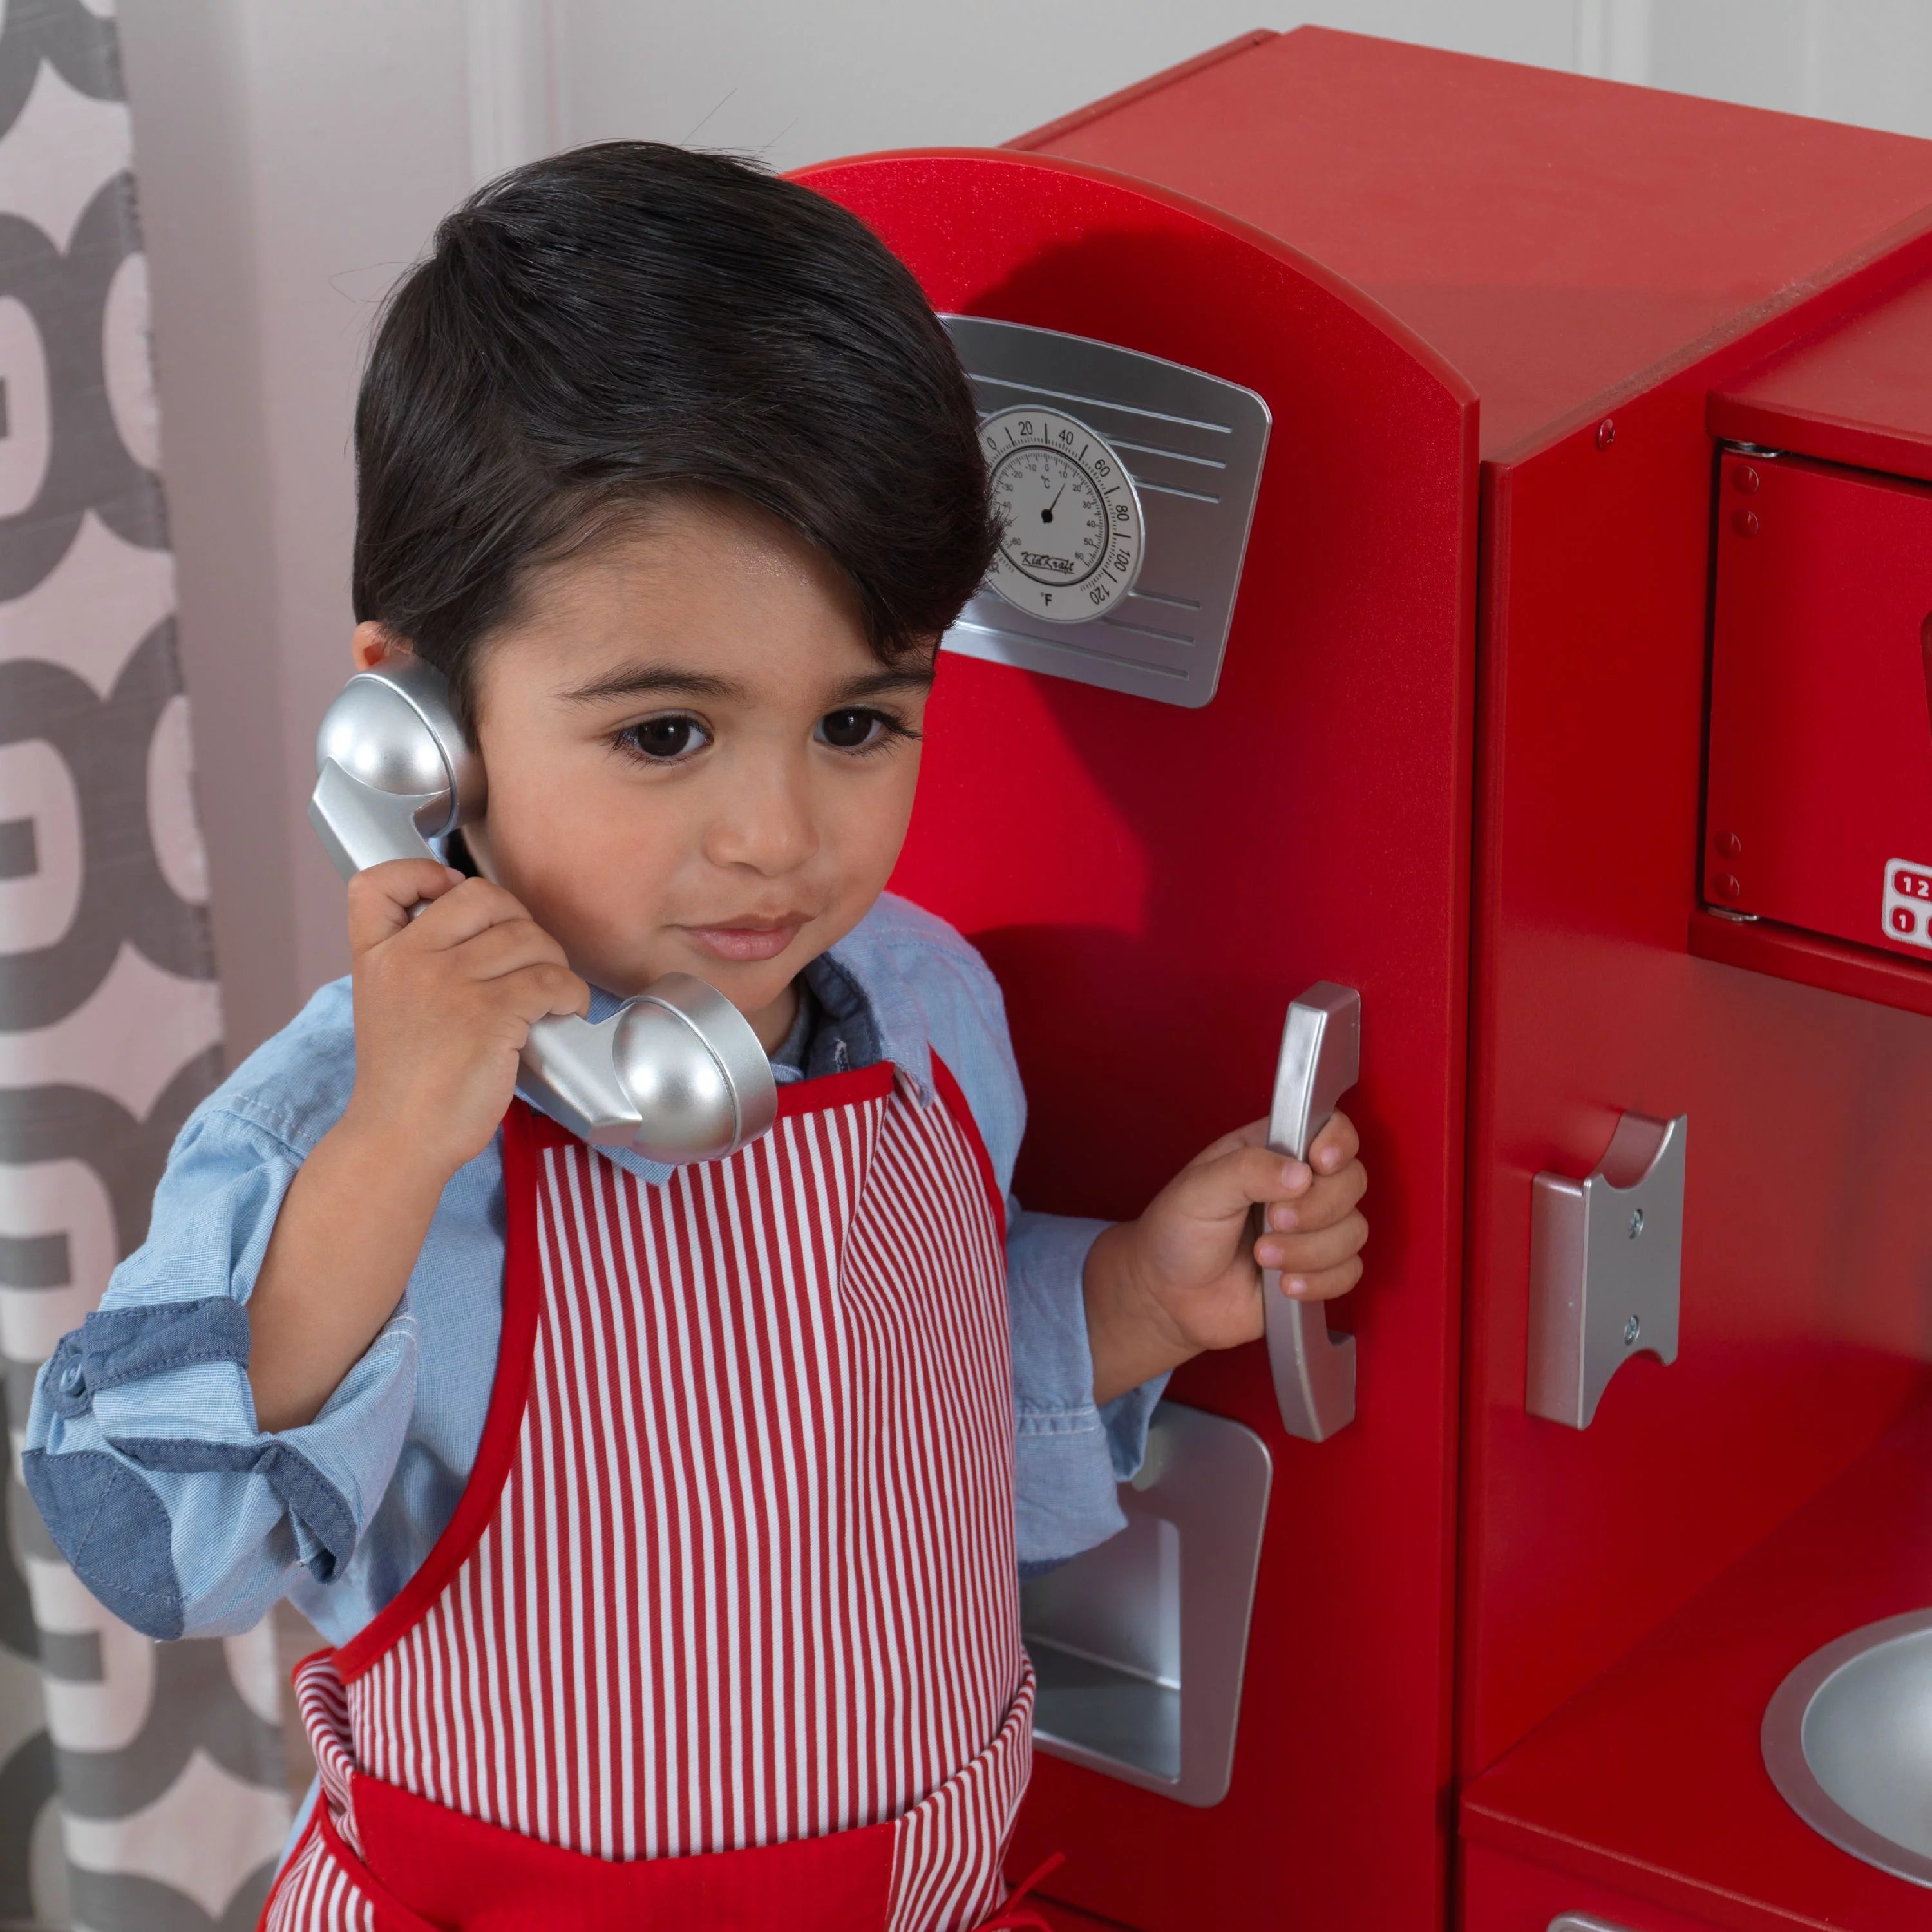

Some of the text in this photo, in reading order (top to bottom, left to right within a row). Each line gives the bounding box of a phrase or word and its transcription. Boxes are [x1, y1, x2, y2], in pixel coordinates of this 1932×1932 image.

[1018, 421, 1033, 435] 20
[1059, 429, 1074, 445] 40
[1095, 459, 1110, 477] 60
[1072, 484, 1081, 492] 20
[1082, 501, 1091, 509] 30
[1116, 504, 1129, 522] 80
[1084, 538, 1093, 546] 50
[1075, 551, 1084, 560] 60
[1114, 549, 1131, 572] 100
[1089, 585, 1110, 605] 120
[1899, 914, 1906, 929] 1
